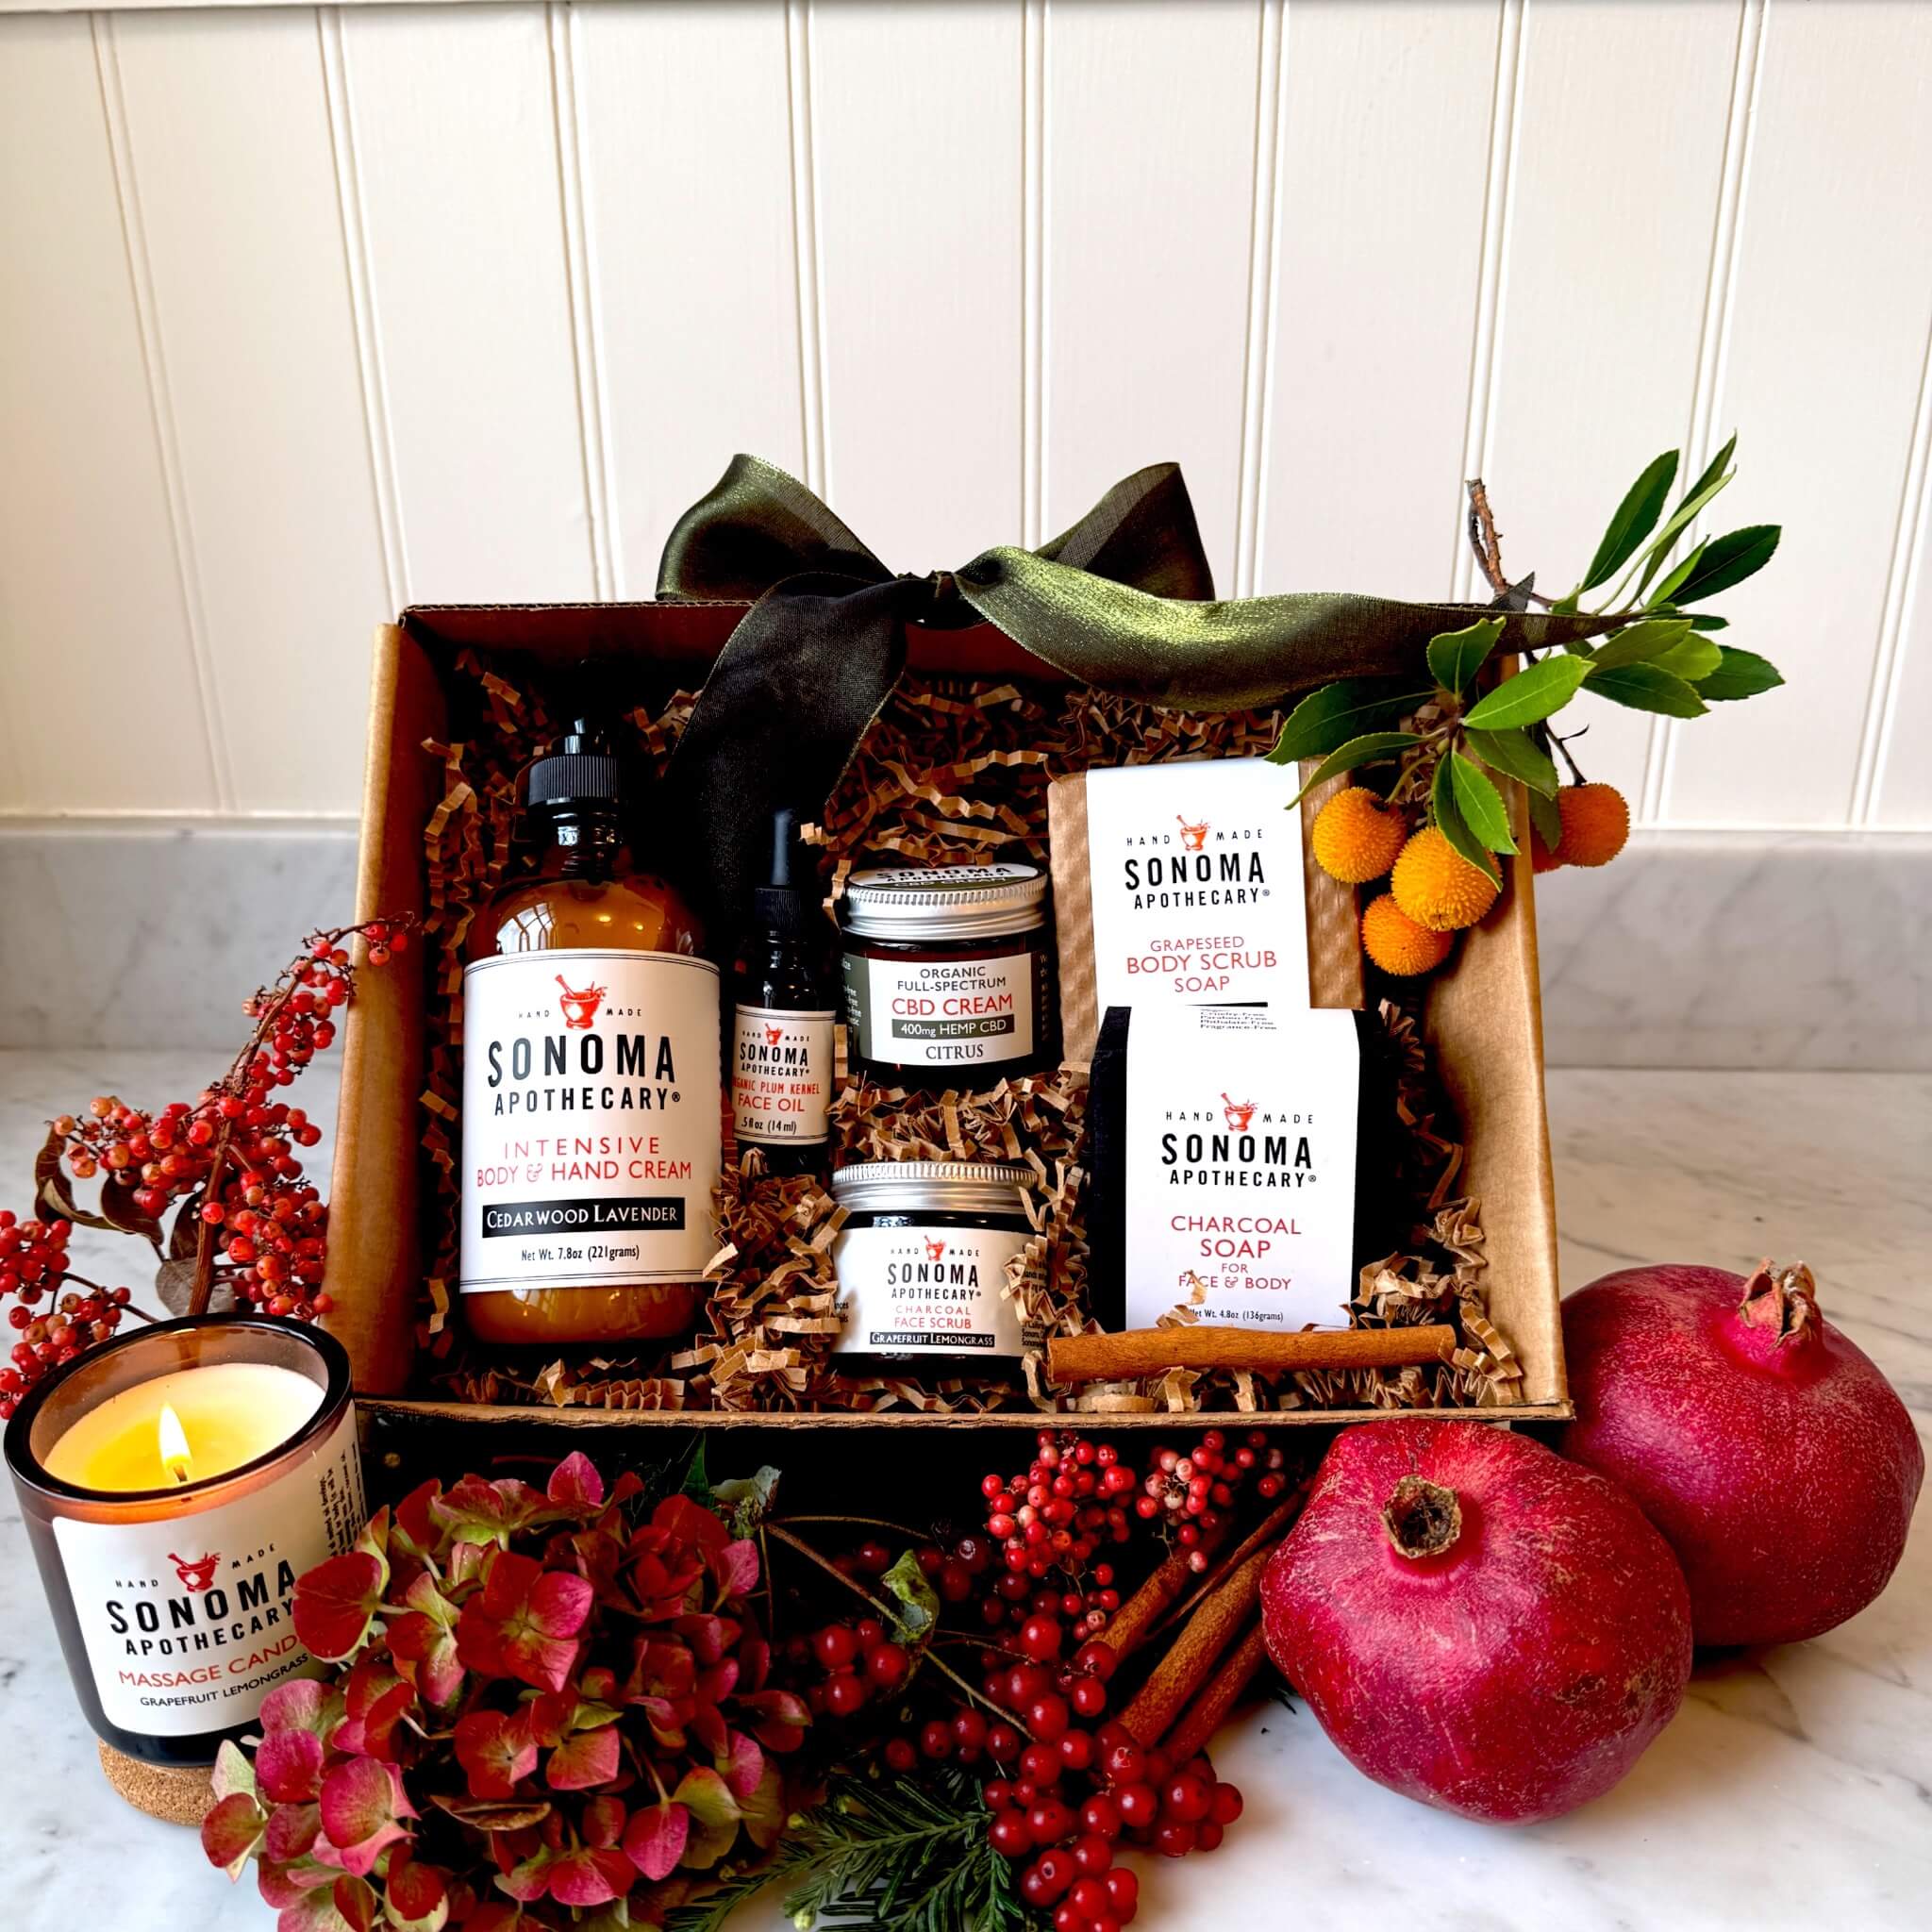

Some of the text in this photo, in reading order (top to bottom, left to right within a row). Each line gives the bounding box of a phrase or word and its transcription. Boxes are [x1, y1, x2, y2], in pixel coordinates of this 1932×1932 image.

[1126, 829, 1263, 846] HAND MADE
[876, 868, 1012, 879] SONOMA
[1124, 852, 1265, 891] SONOMA
[1150, 936, 1245, 952] GRAPESEED
[1127, 951, 1276, 974] BODY SCRUB
[920, 966, 986, 979] ORGANIC
[897, 976, 1006, 991] FULL-SPECTRUM
[1174, 975, 1230, 993] SOAP
[607, 1008, 641, 1016] MADE
[891, 993, 1012, 1016] CBD CREAM
[901, 1019, 1006, 1037] 400mg HEMP CBD
[740, 1042, 808, 1066] SONOMA
[925, 1044, 983, 1059] CITRUS
[488, 1034, 675, 1088] SONOMA
[760, 1081, 785, 1094] PLUM
[791, 1083, 821, 1094] KERNEL
[738, 1093, 805, 1112] FACE OIL
[1166, 1111, 1313, 1124] HAND MADE
[505, 1137, 660, 1159] INTENSIVE
[1161, 1133, 1312, 1169] SONOMA
[477, 1160, 691, 1187] BODY & HAND CREAM
[1171, 1216, 1302, 1235] CHARCOAL
[521, 1245, 640, 1262] Net Wt. 7.8oz (221grams)
[1200, 1240, 1271, 1258] SOAP
[887, 1262, 978, 1288] SONOMA
[1222, 1263, 1248, 1274] FOR
[1178, 1275, 1291, 1291] FACE & BODY
[896, 1305, 971, 1316] CHARCOAL
[1220, 1309, 1239, 1319] 4.8oz
[1242, 1310, 1283, 1323] (136grams)
[894, 1317, 972, 1329] FACE SCRUB
[115, 1543, 275, 1589] HAND MADE
[106, 1559, 296, 1634] SONOMA
[119, 1635, 298, 1687] MASSAGE CAND
[140, 1653, 308, 1707] GRAPEFRUIT LEMONGRASS
